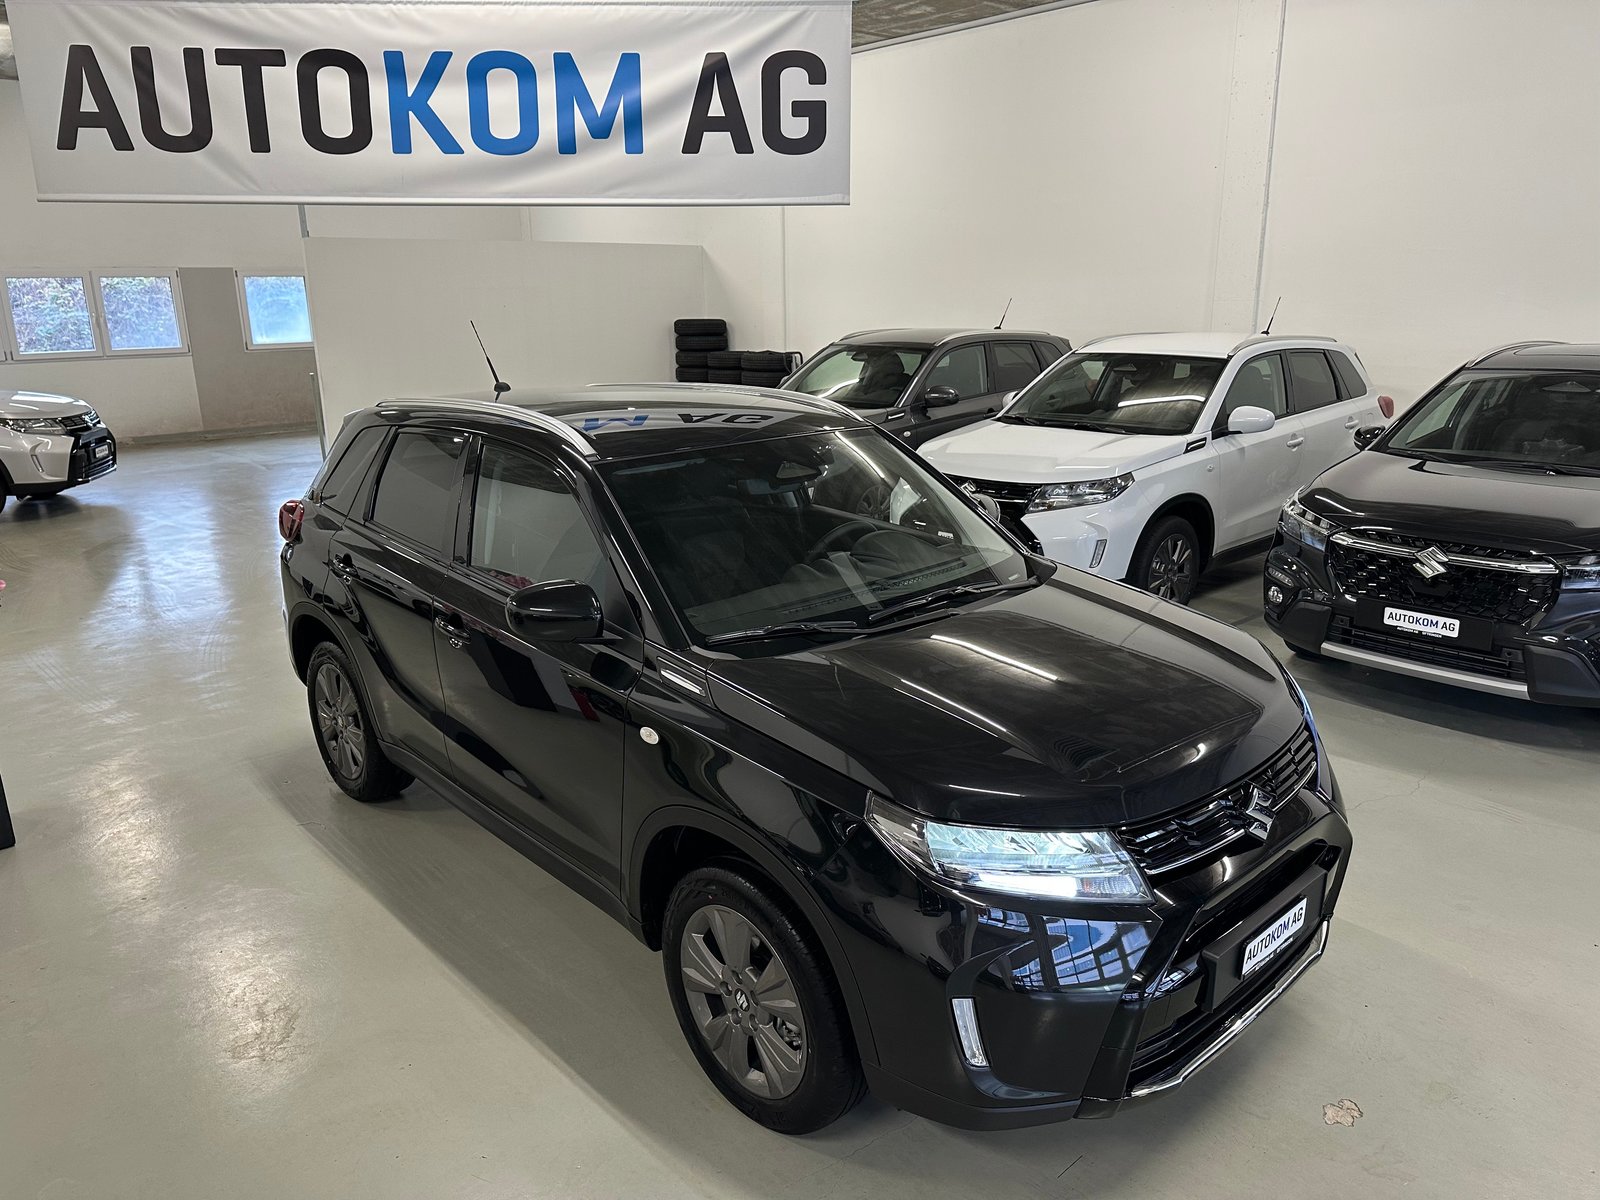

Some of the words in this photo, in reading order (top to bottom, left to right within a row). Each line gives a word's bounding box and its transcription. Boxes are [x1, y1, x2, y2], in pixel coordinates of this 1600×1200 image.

[56, 44, 645, 156] AUTOKOM
[681, 49, 828, 156] AG
[1387, 611, 1439, 629] AUTOKOM
[1440, 621, 1456, 632] AG
[1245, 916, 1290, 965] AUTOKOM
[1290, 906, 1304, 928] AG
